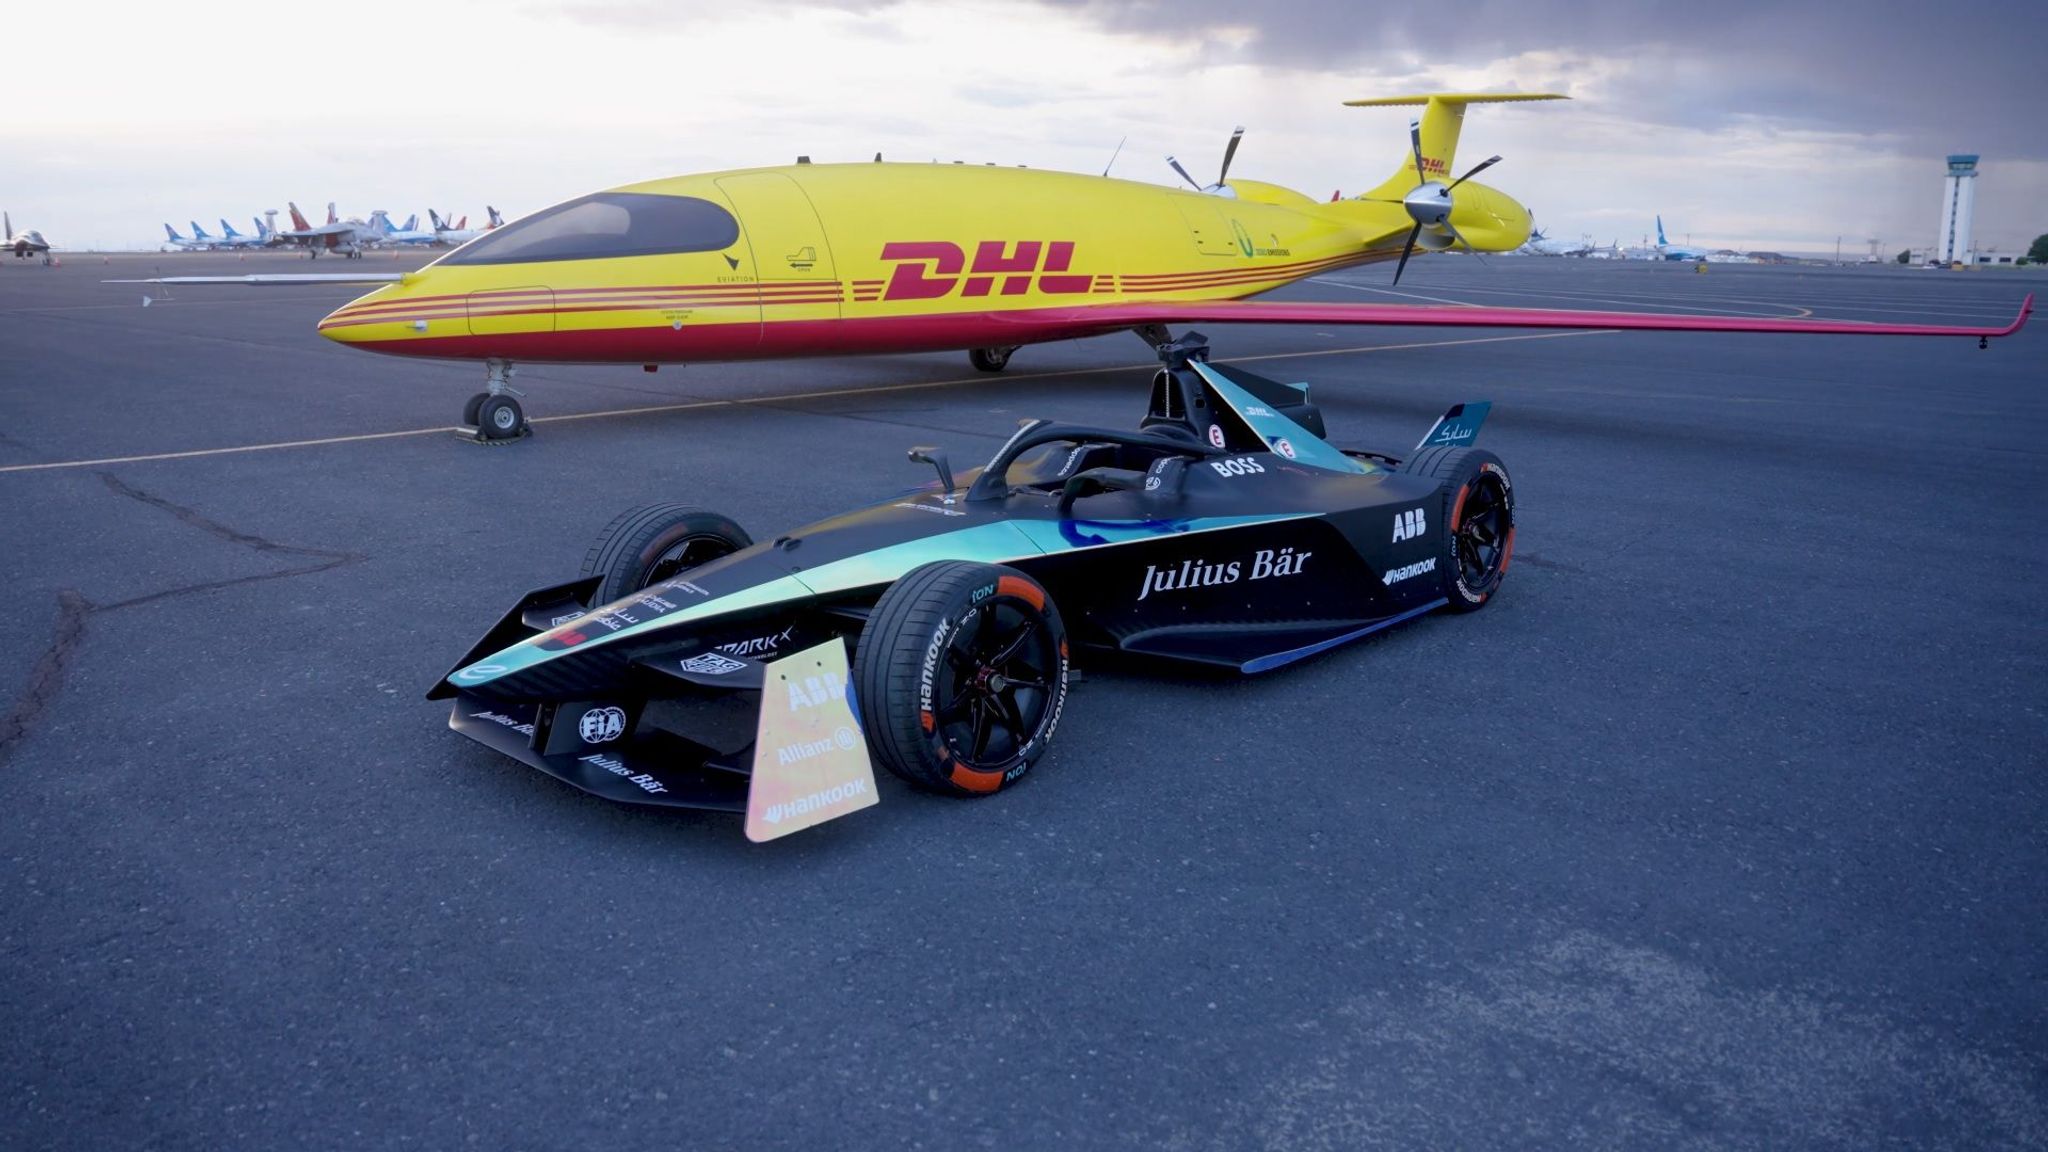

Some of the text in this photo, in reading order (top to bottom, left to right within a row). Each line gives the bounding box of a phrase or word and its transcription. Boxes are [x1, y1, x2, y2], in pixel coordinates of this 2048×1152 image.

[717, 275, 755, 283] EVIATION
[880, 241, 1093, 301] DHL
[1210, 457, 1266, 478] BOSS
[1392, 508, 1426, 543] ABB
[1137, 547, 1312, 601] Julius Bär
[702, 654, 738, 669] TAG
[788, 672, 847, 712] ABB
[777, 737, 834, 766] Allianz
[578, 753, 668, 794] Julius Bär
